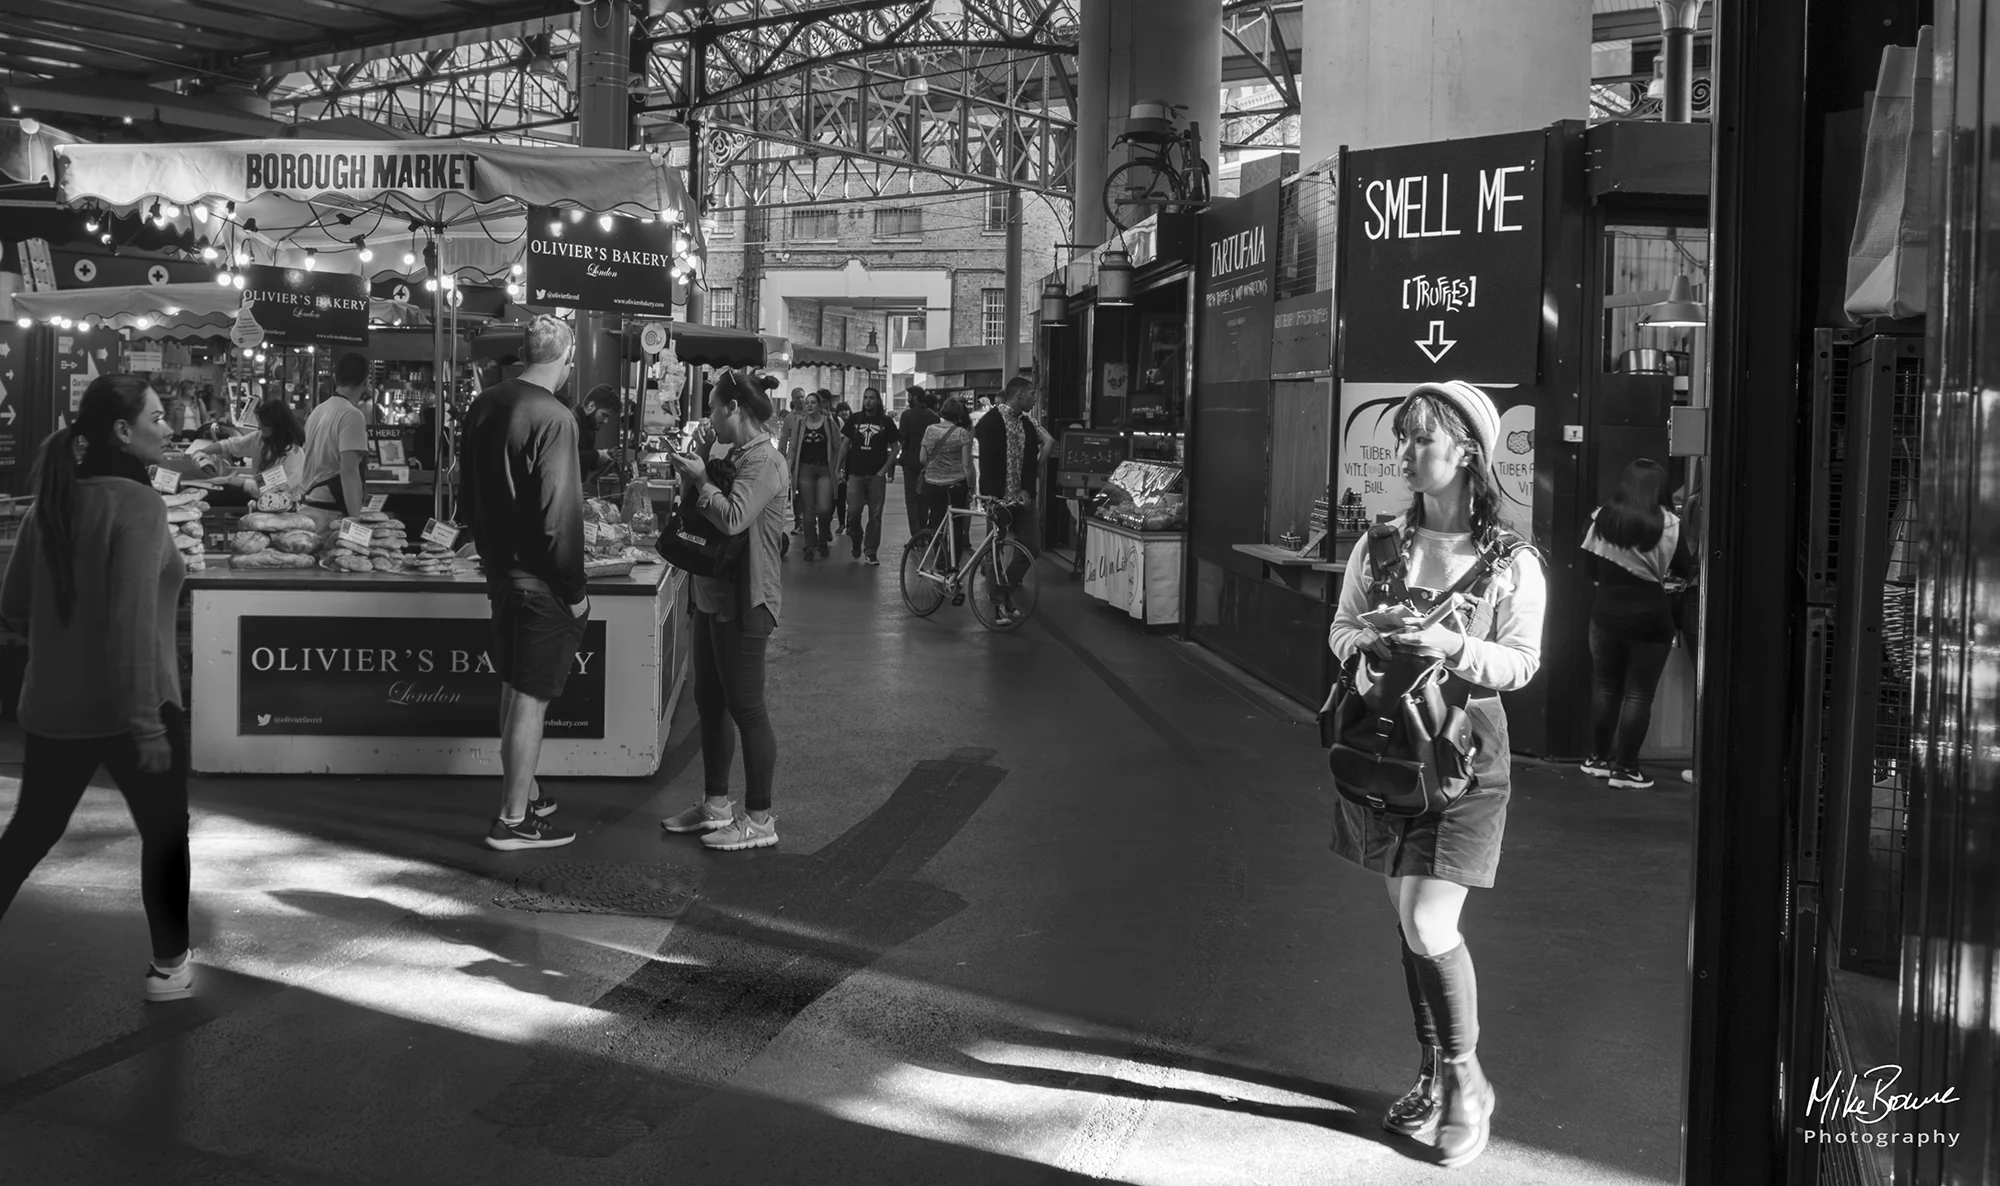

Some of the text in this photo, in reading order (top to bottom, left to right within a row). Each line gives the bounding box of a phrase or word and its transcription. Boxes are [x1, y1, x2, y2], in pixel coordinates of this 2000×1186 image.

[246, 153, 479, 190] BOROUGH MARKET
[531, 240, 669, 268] OLIVIER'S BAKERY
[1210, 225, 1266, 278] TARTUFAIA
[586, 263, 618, 278] London
[243, 289, 367, 311] OLIVIER'S BAKERY
[292, 307, 320, 318] London
[375, 429, 401, 437] HERE?
[1359, 445, 1392, 461] TUBER
[1497, 461, 1528, 477] TUBER
[1364, 480, 1388, 495] BULL.
[251, 646, 595, 675] OLIVIER'S BAY
[384, 680, 464, 705] London
[273, 715, 322, 725] @olivierfavrel
